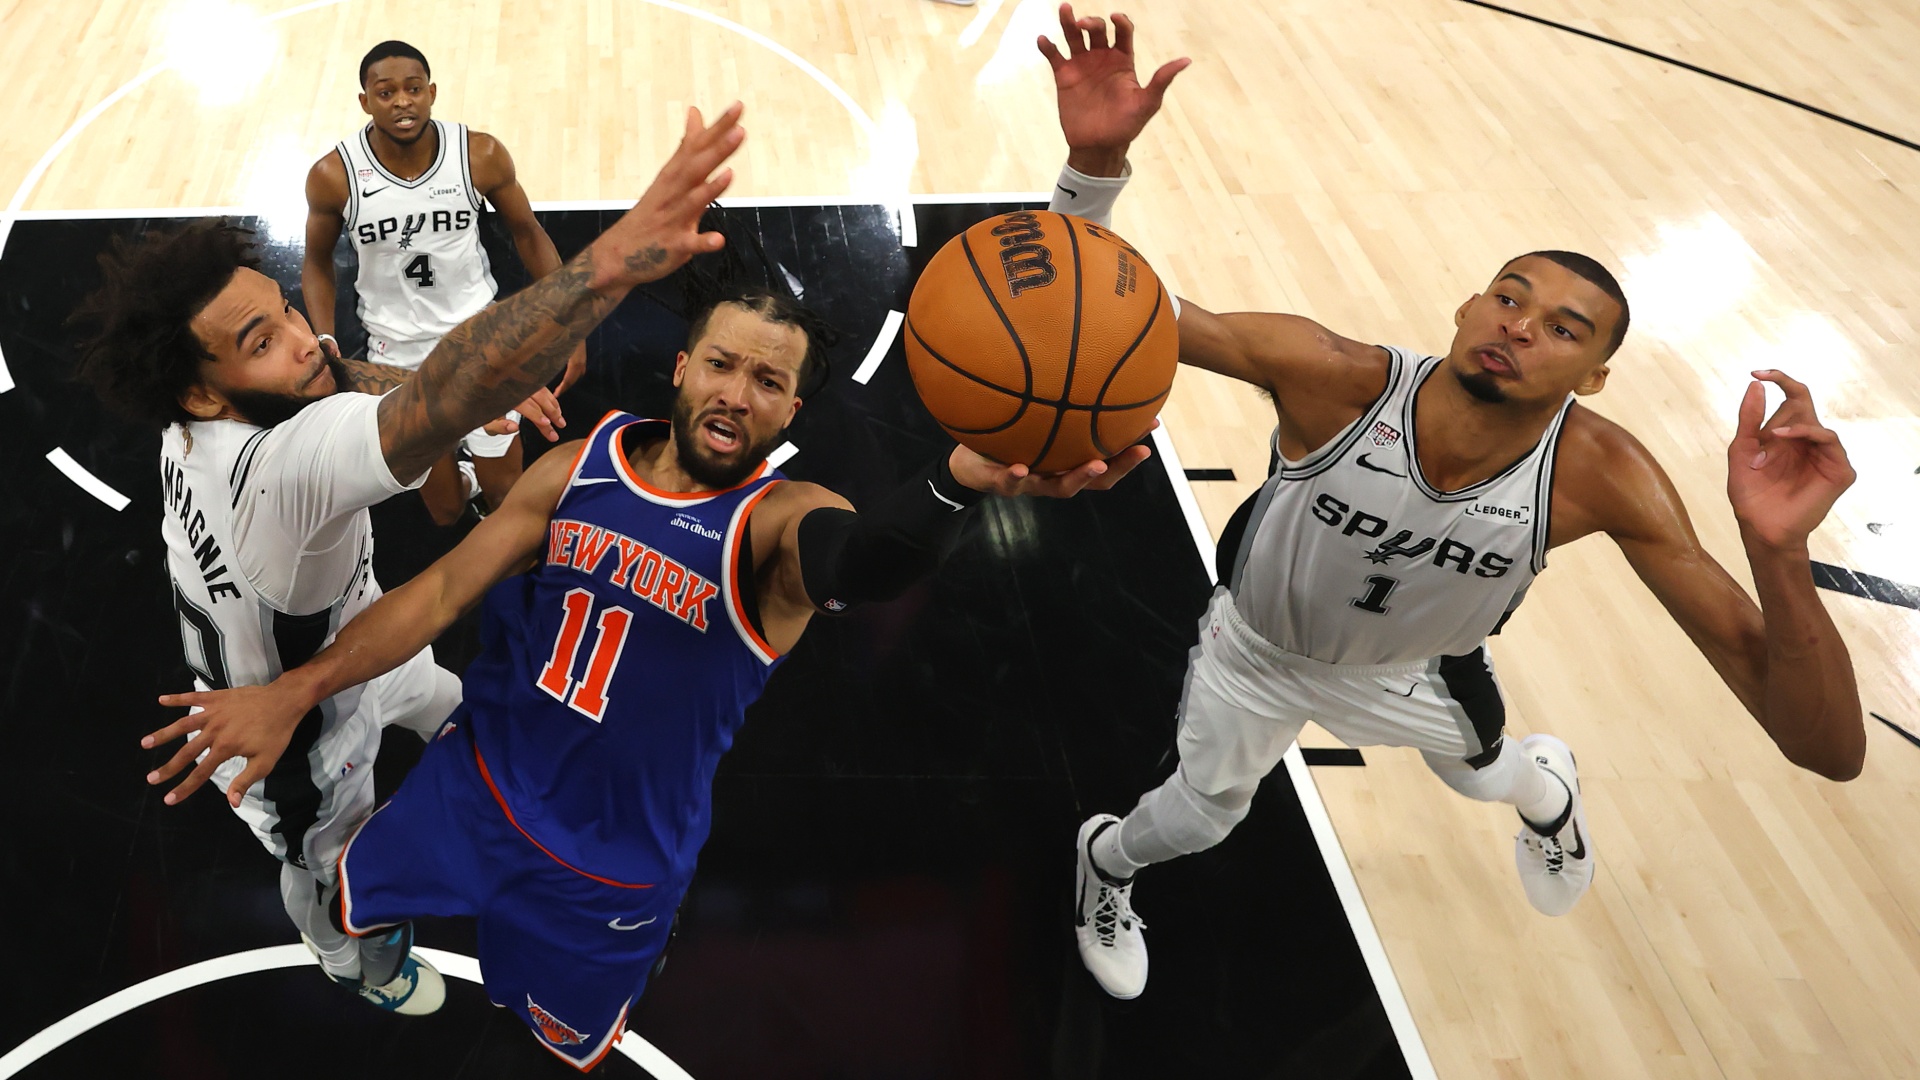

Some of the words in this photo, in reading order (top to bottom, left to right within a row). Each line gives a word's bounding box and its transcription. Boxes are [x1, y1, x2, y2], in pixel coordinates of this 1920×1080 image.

[433, 188, 457, 196] LEDGER
[358, 210, 471, 250] SPURS
[402, 253, 436, 290] 4
[1377, 423, 1398, 438] USA
[670, 517, 690, 530] abu
[690, 523, 723, 541] dhabi
[1474, 503, 1522, 520] LEDGER
[1312, 493, 1514, 579] SPURS
[546, 519, 616, 575] NEW
[609, 537, 721, 634] YORK
[1349, 573, 1400, 616] 1
[536, 587, 635, 724] 11
